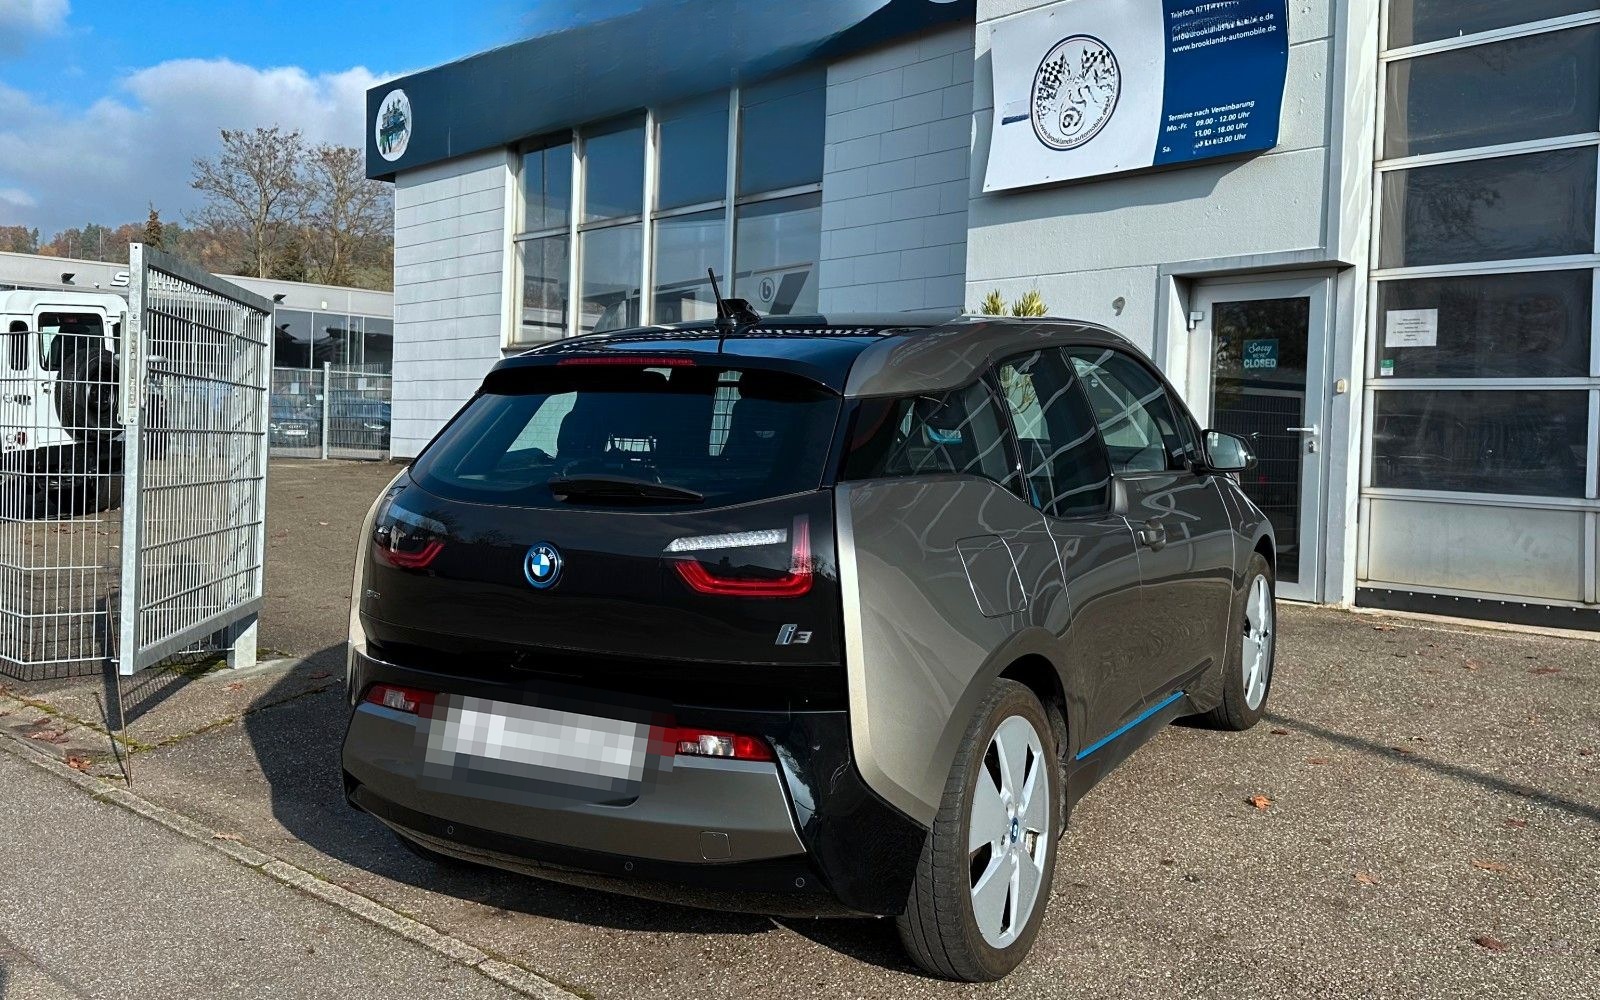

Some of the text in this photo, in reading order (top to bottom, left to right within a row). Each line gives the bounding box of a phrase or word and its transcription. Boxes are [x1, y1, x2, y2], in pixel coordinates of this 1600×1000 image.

[1172, 24, 1277, 53] www.brooklands-automobile.de
[1168, 100, 1255, 121] Termine nach Vereinbarung
[1195, 118, 1214, 127] 09.00
[1219, 114, 1236, 122] 12.00
[1238, 111, 1251, 119] Uhr
[1218, 124, 1235, 133] 18.00
[1235, 122, 1248, 130] Uhr
[1248, 342, 1272, 356] Sorry
[1243, 358, 1276, 368] CLOSED
[530, 547, 555, 560] BMW
[775, 623, 813, 645] i3
